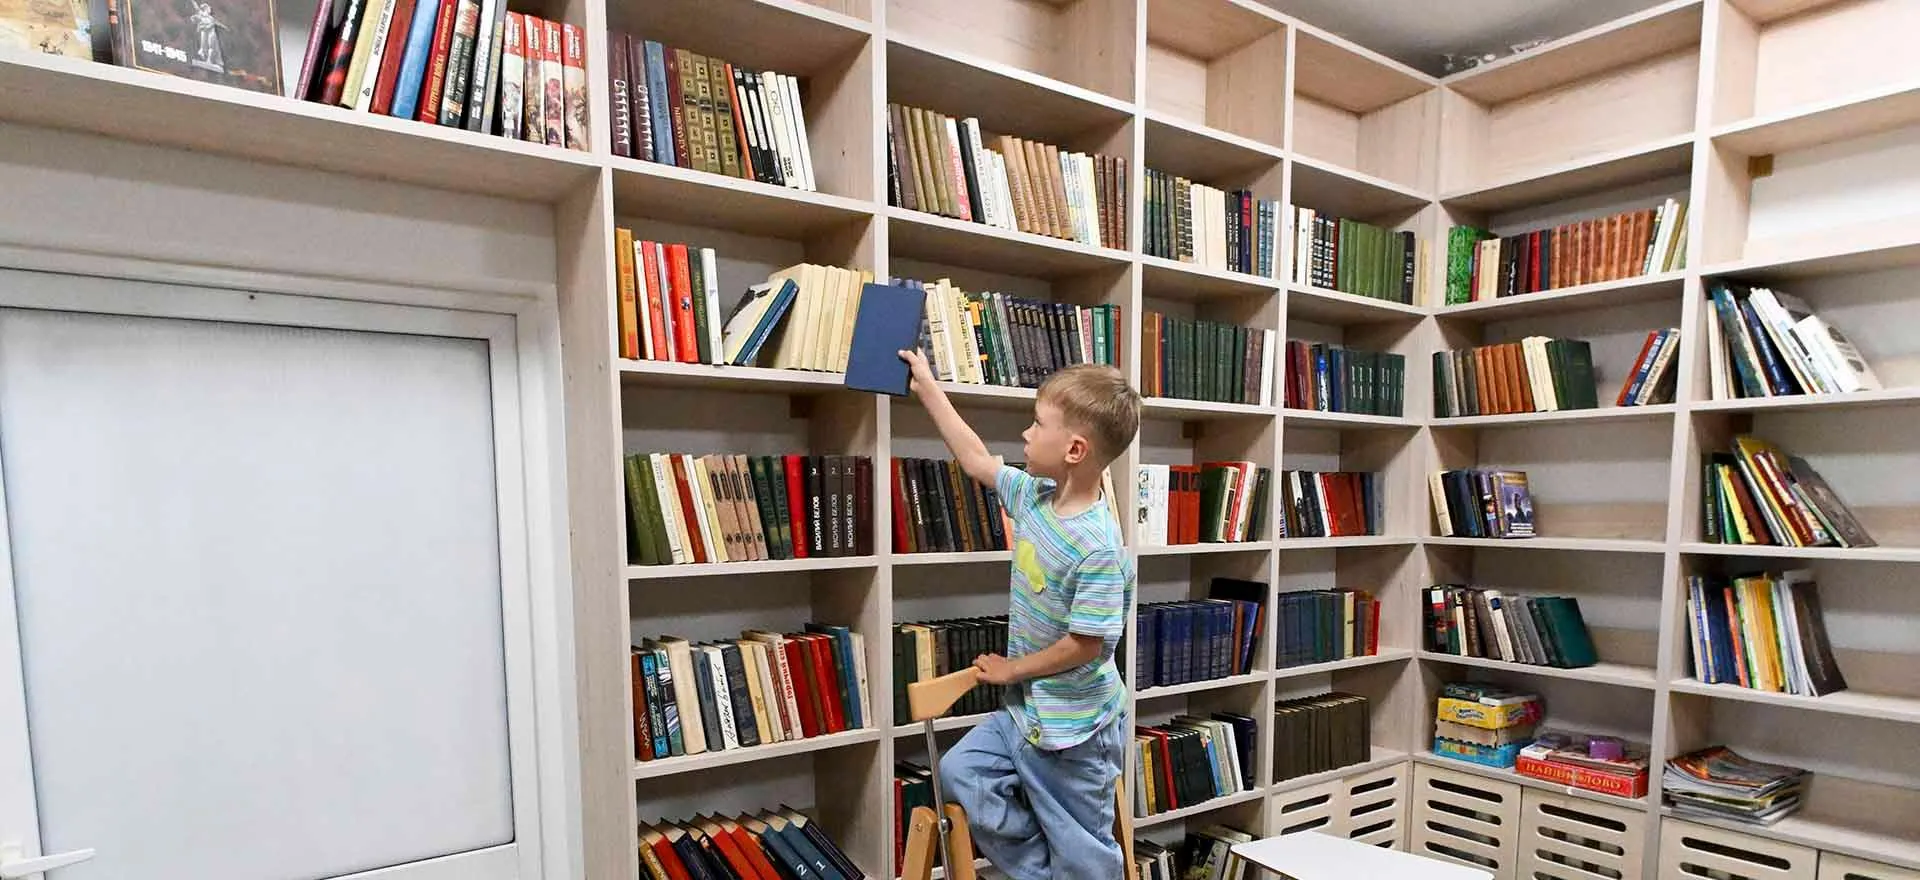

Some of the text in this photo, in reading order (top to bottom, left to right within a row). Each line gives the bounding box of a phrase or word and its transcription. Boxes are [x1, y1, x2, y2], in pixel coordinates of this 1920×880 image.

[812, 495, 823, 551] ВАСИЛИЙ БЕЛОВ
[830, 494, 840, 549] ВАСИЛИЙ БЕЛОВ
[796, 863, 807, 876] 2
[815, 860, 826, 871] 1
